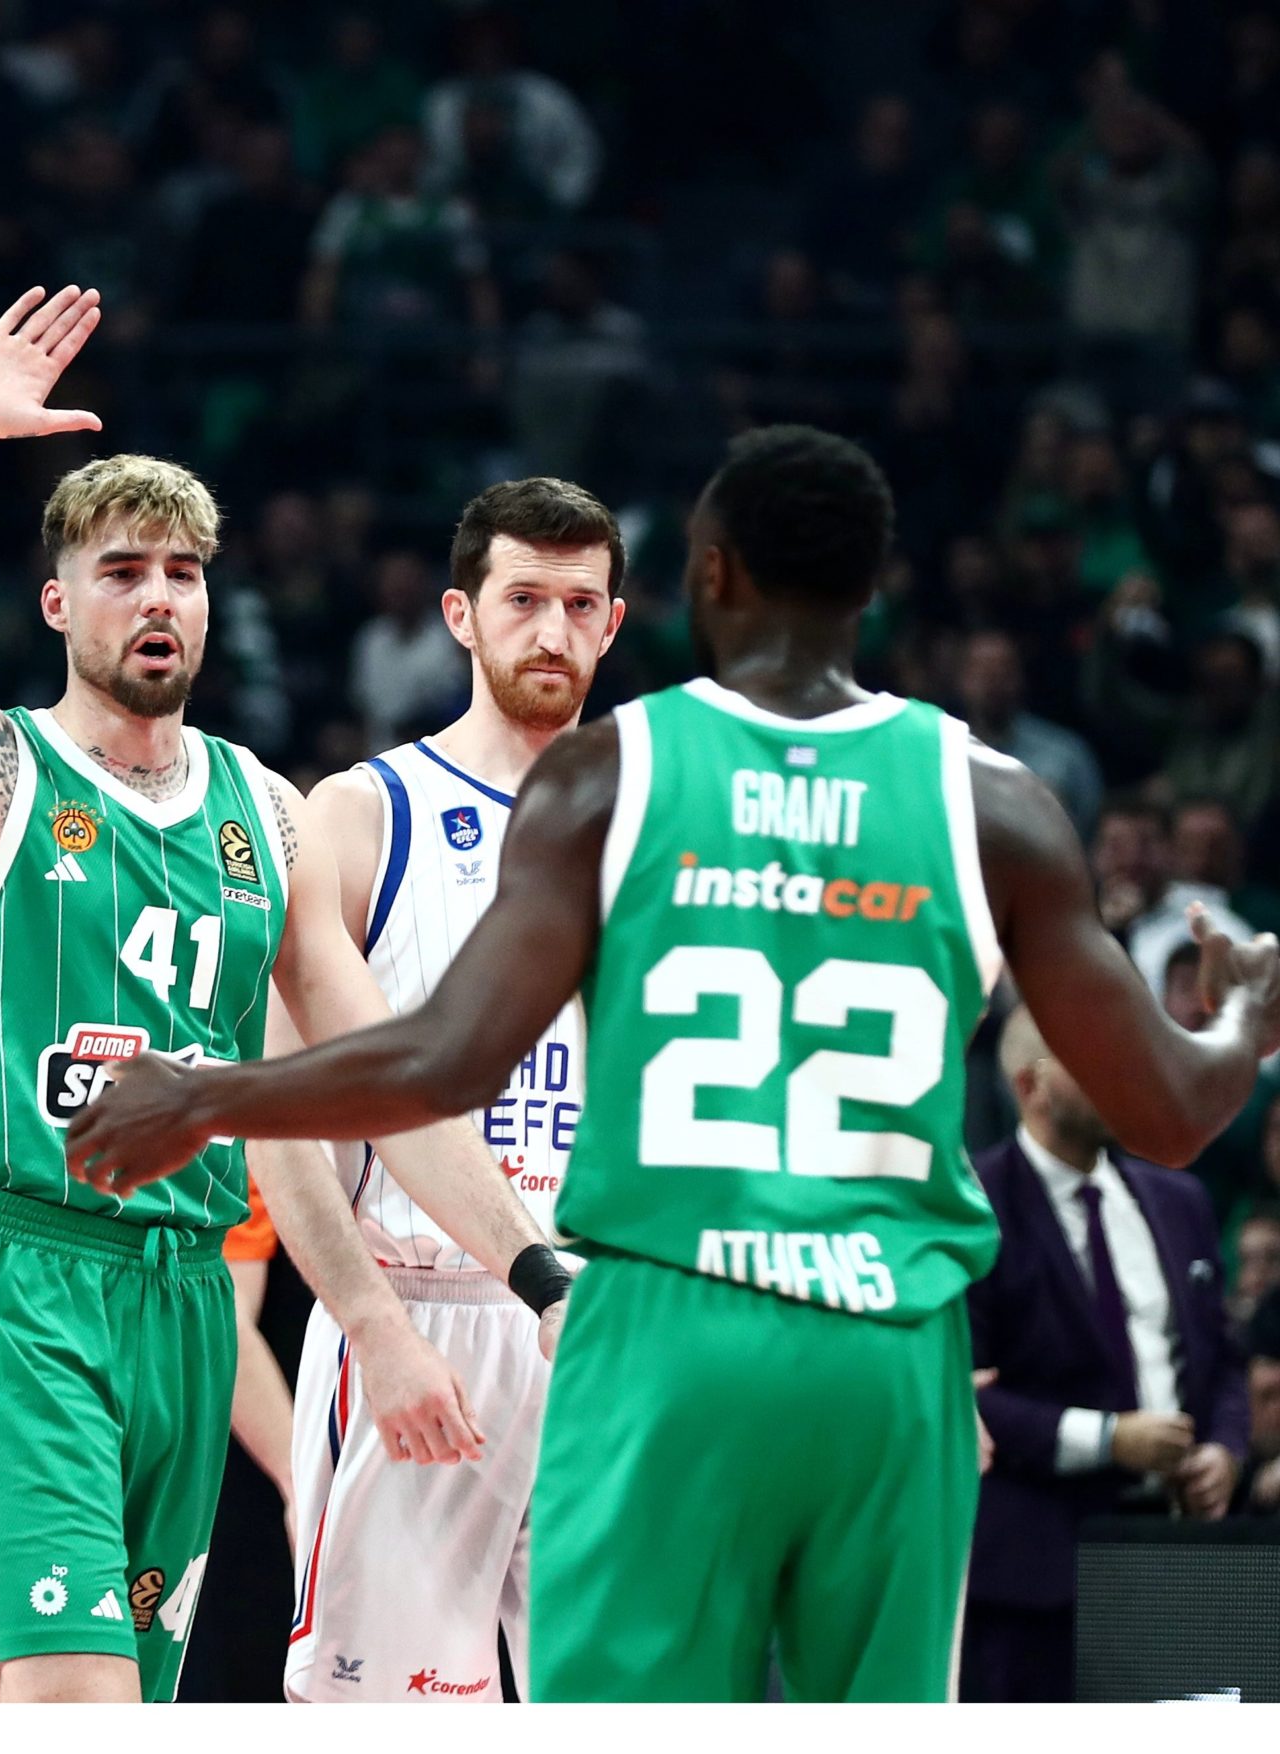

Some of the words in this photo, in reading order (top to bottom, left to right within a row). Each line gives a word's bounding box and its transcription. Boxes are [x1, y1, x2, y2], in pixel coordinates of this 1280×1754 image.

[732, 768, 868, 847] GRANT
[223, 888, 270, 910] oneteam
[672, 852, 932, 922] instacar
[120, 905, 222, 1010] 41
[78, 1035, 137, 1058] pame
[638, 945, 949, 1181] 22
[484, 1098, 582, 1151] EFE
[520, 1174, 559, 1191] core
[52, 1564, 68, 1577] bp
